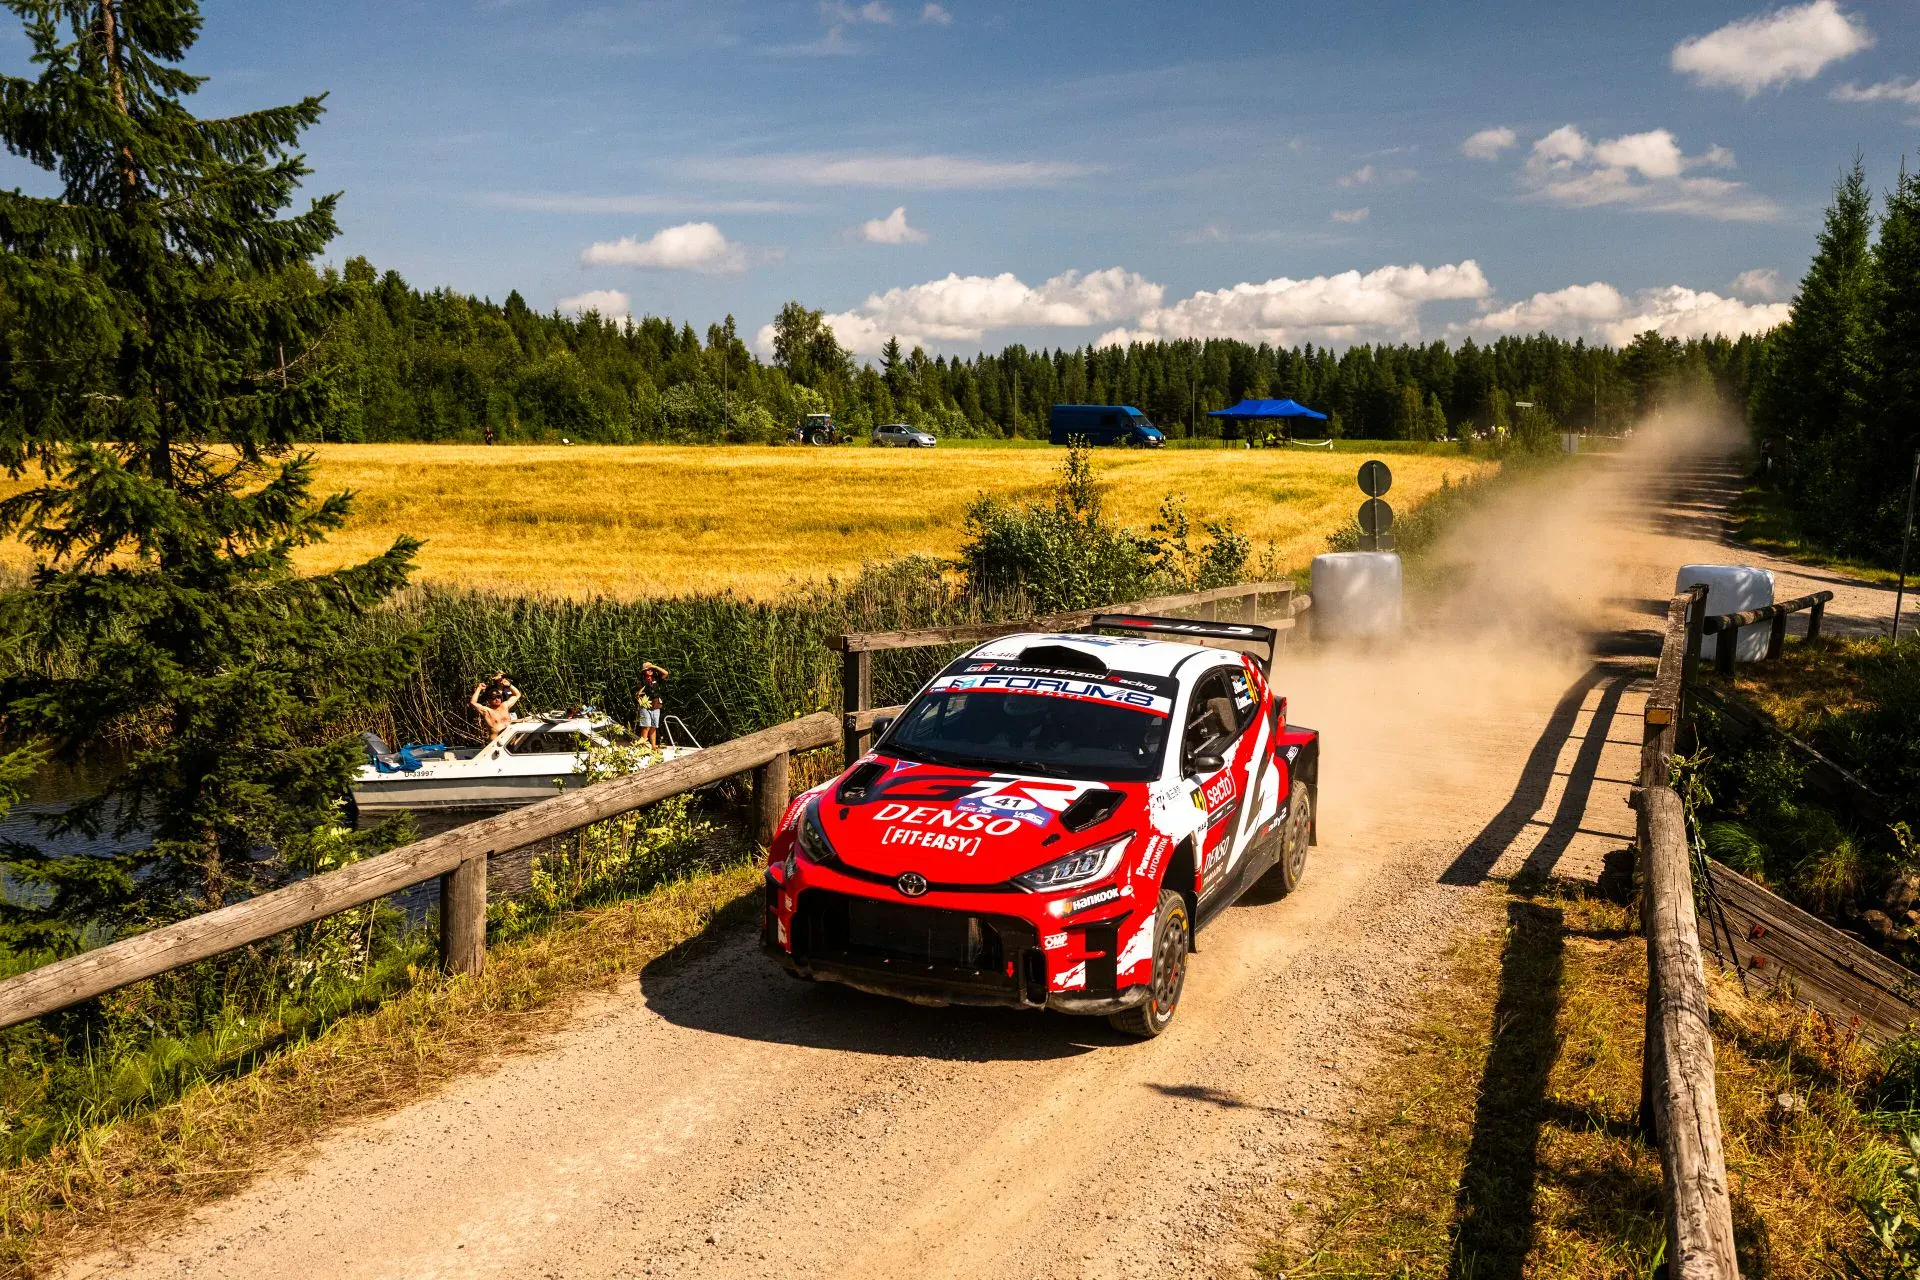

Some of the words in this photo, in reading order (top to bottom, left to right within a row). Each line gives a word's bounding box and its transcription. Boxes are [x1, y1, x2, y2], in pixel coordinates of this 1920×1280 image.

[979, 676, 1154, 707] FORUM8
[996, 665, 1050, 674] TOYOTA
[1053, 669, 1106, 680] GAZOO
[1107, 675, 1158, 691] Racing
[995, 798, 1022, 808] 41
[1206, 776, 1233, 809] secto
[872, 803, 1021, 836] DENSO
[1135, 834, 1161, 877] Panasonic
[1147, 837, 1170, 880] AUTOMOTIVE
[1043, 931, 1068, 951] OMP
